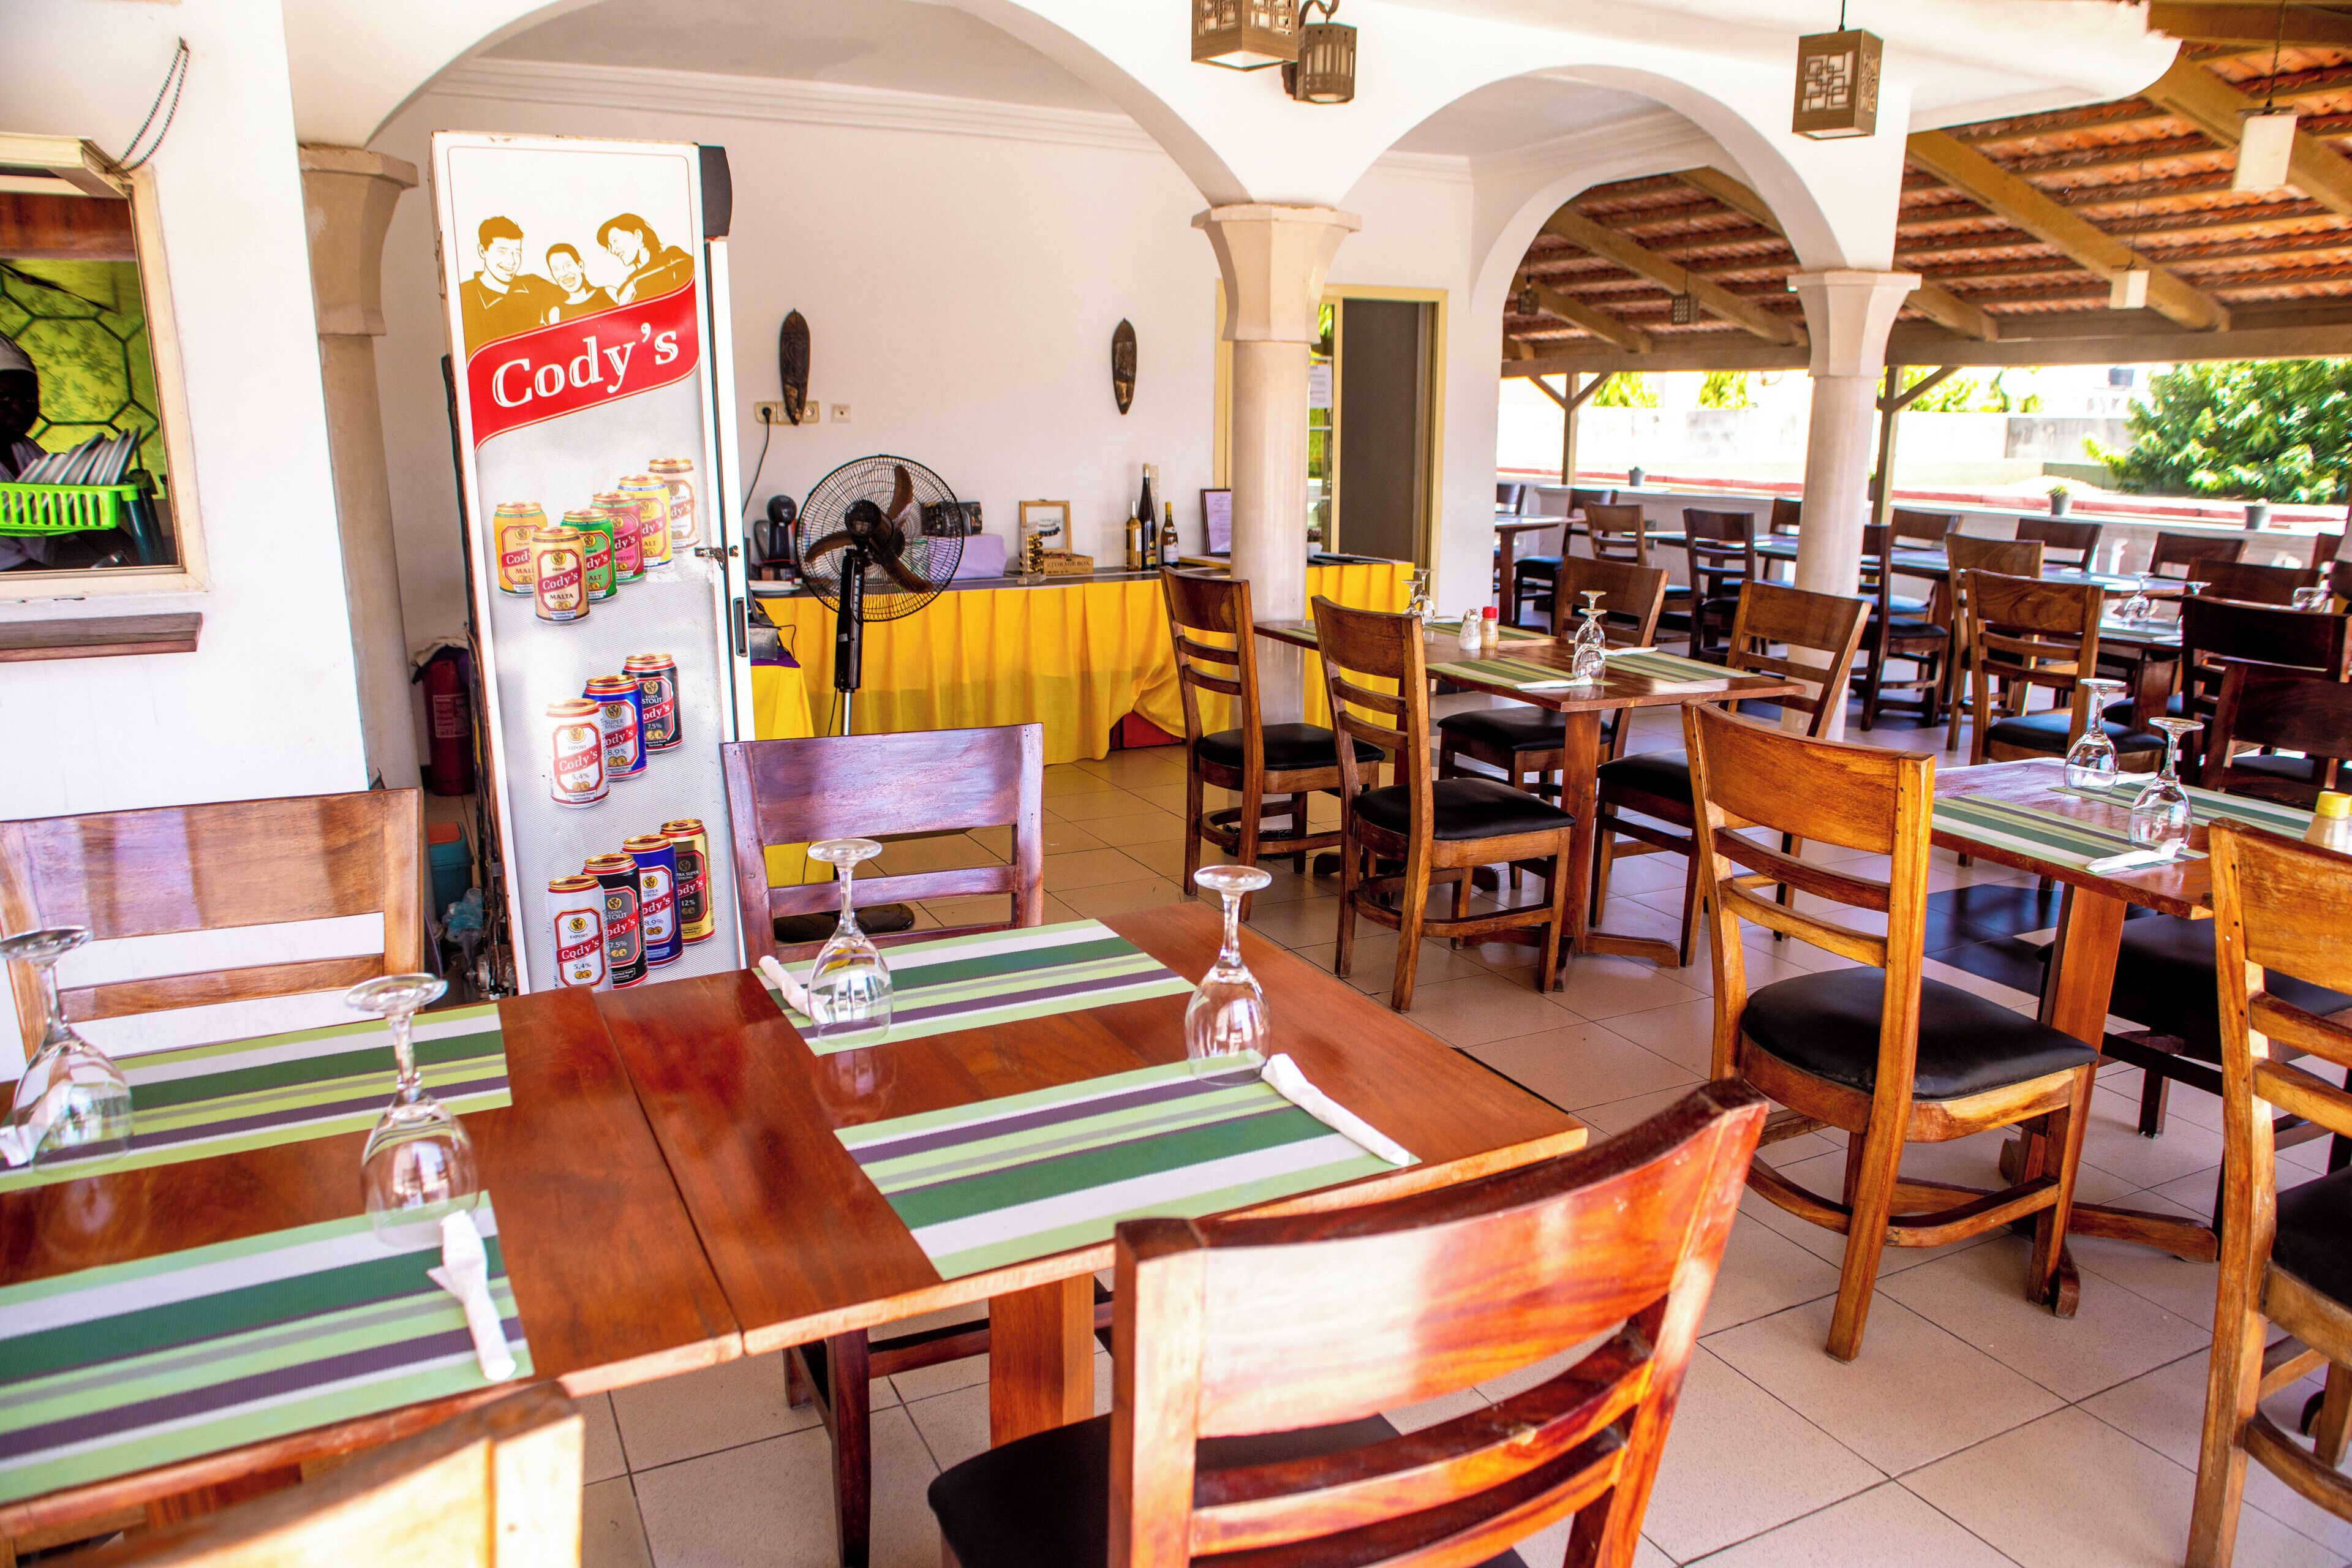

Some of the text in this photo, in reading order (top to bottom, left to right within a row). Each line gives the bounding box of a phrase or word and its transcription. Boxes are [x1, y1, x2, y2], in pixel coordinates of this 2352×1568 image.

[492, 322, 679, 409] Cody's
[671, 503, 691, 519] dy's
[642, 520, 663, 535] dy's
[614, 535, 636, 550] dy's
[506, 550, 531, 565] Cod
[587, 554, 608, 569] dy's
[542, 572, 578, 590] Cody's
[643, 704, 670, 720] ody's
[606, 729, 634, 746] ody's
[559, 750, 598, 772] Cody's
[677, 880, 703, 895] ody's
[643, 897, 671, 915] ody's
[607, 911, 628, 920] TOUT
[606, 918, 636, 937] ody's
[561, 940, 600, 960] Cody's
